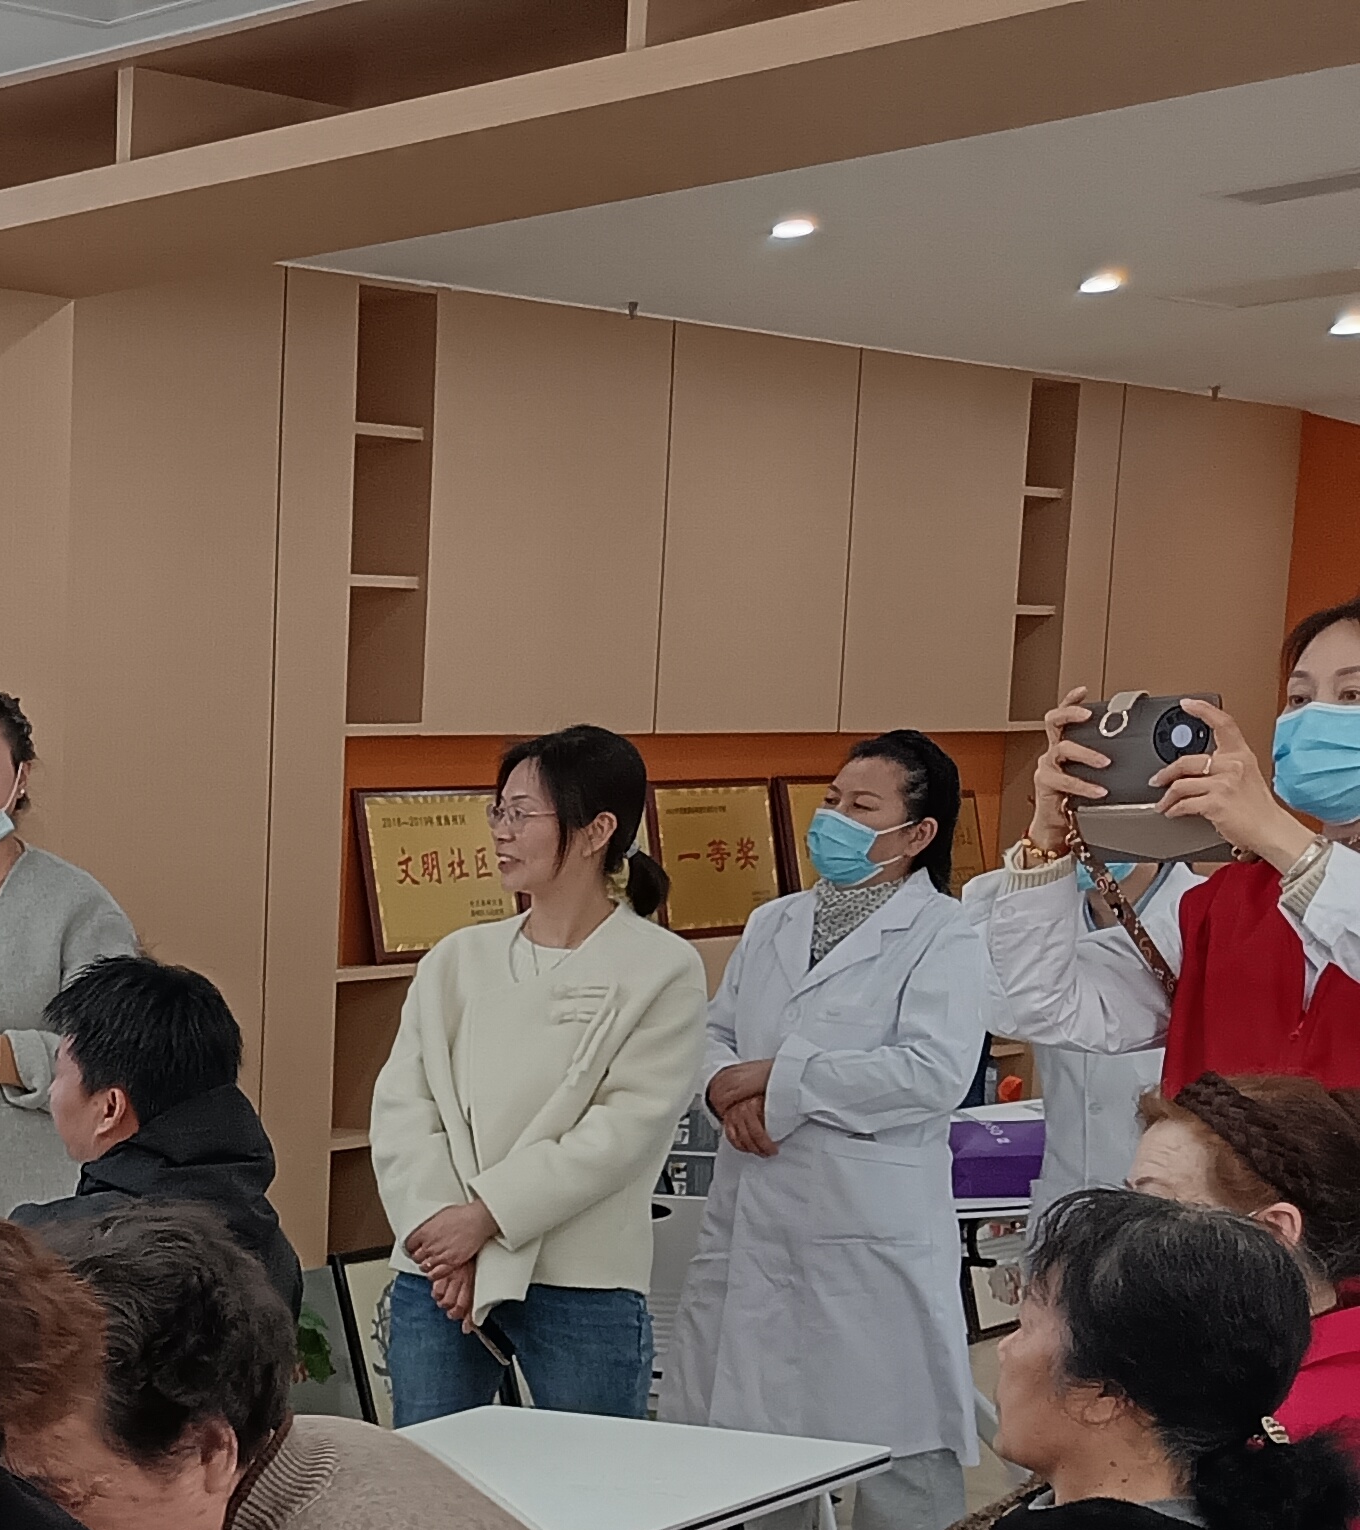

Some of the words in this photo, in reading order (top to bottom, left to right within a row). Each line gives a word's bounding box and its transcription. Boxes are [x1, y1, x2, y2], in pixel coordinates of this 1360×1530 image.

[396, 846, 494, 886] 文明社区
[677, 836, 760, 873] 一等奖
